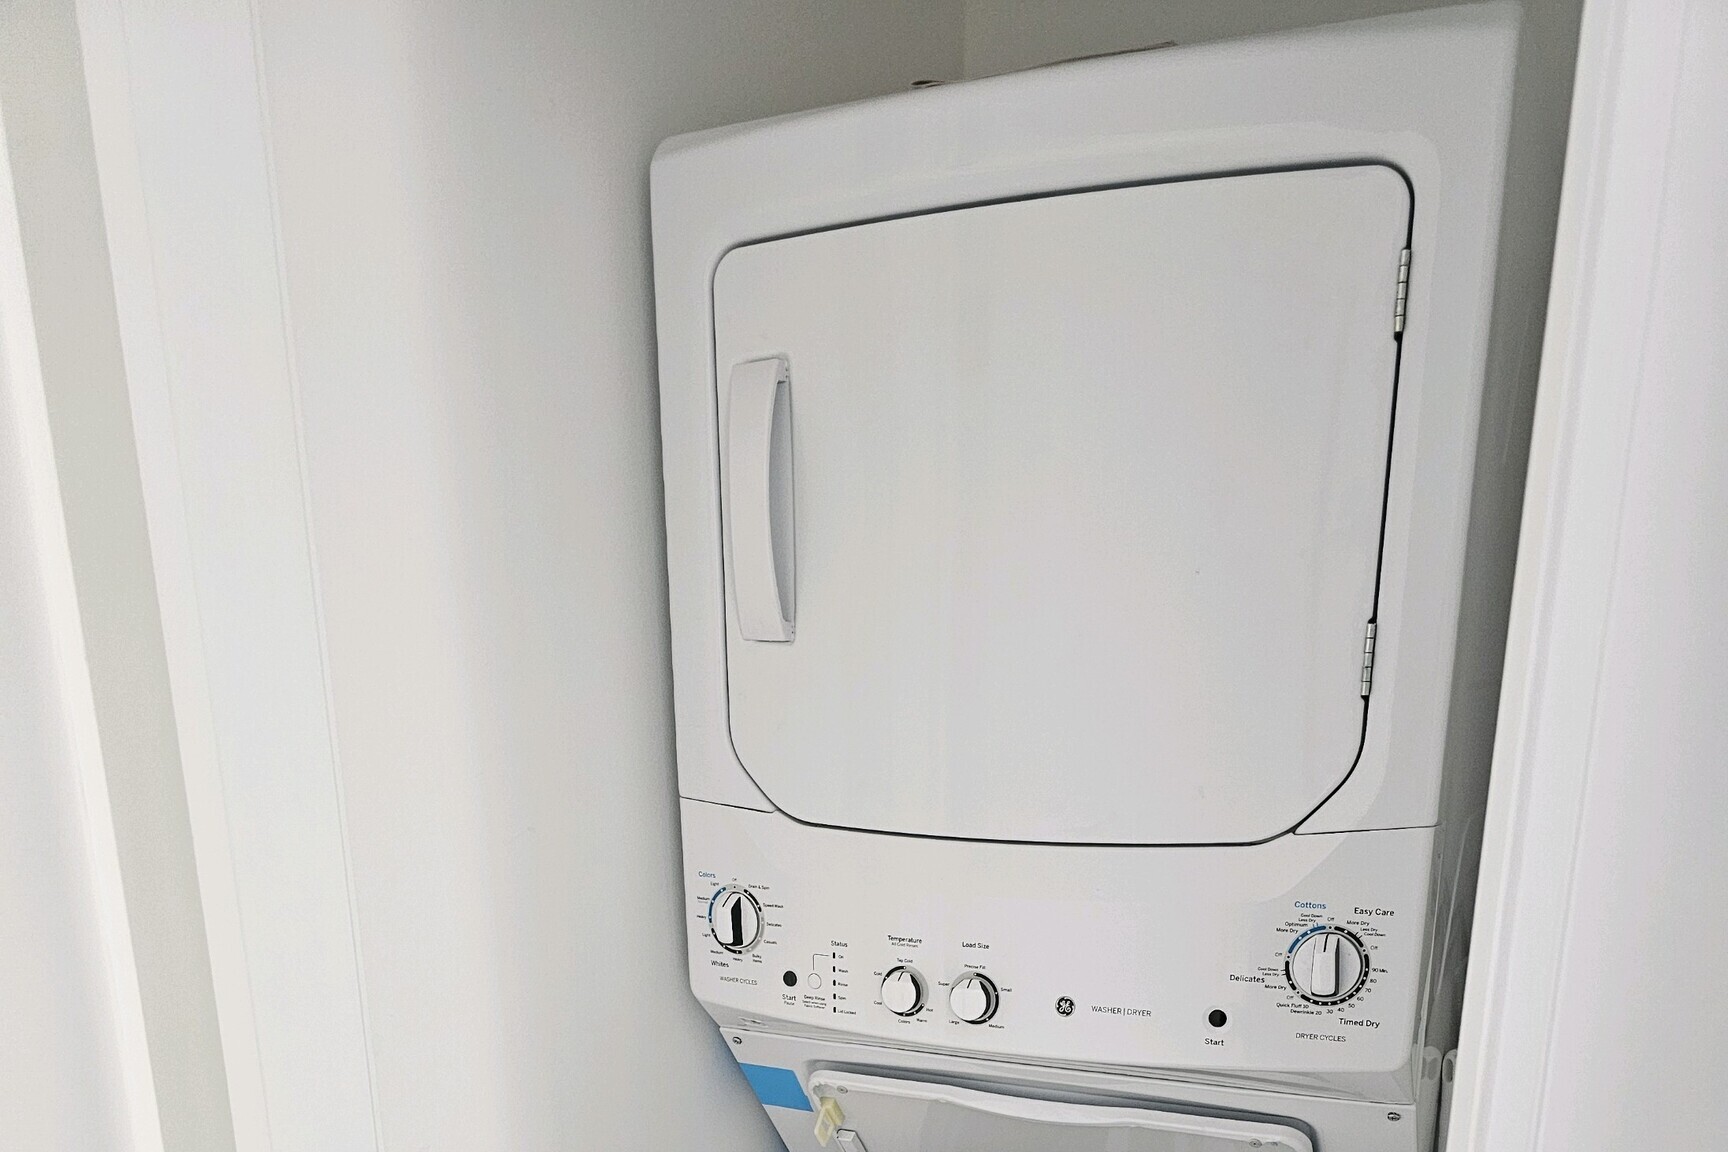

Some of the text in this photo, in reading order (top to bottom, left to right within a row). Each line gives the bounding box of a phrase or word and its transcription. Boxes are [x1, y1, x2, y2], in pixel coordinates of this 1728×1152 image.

[699, 871, 716, 879] Colors
[1294, 900, 1327, 909] Cottons
[1354, 907, 1395, 916] Easy Care
[887, 934, 922, 944] Temperature
[831, 940, 848, 948] Status
[962, 941, 976, 949] Load
[711, 960, 729, 968] Whites
[740, 978, 758, 986] CYCLES
[1230, 974, 1265, 983] Delicates
[782, 993, 796, 1001] Start
[1091, 1005, 1151, 1017] WASHER DRYER
[1338, 1018, 1380, 1029] Timed Dry
[1204, 1038, 1225, 1046] Start
[1320, 1034, 1347, 1042] CYCLES
